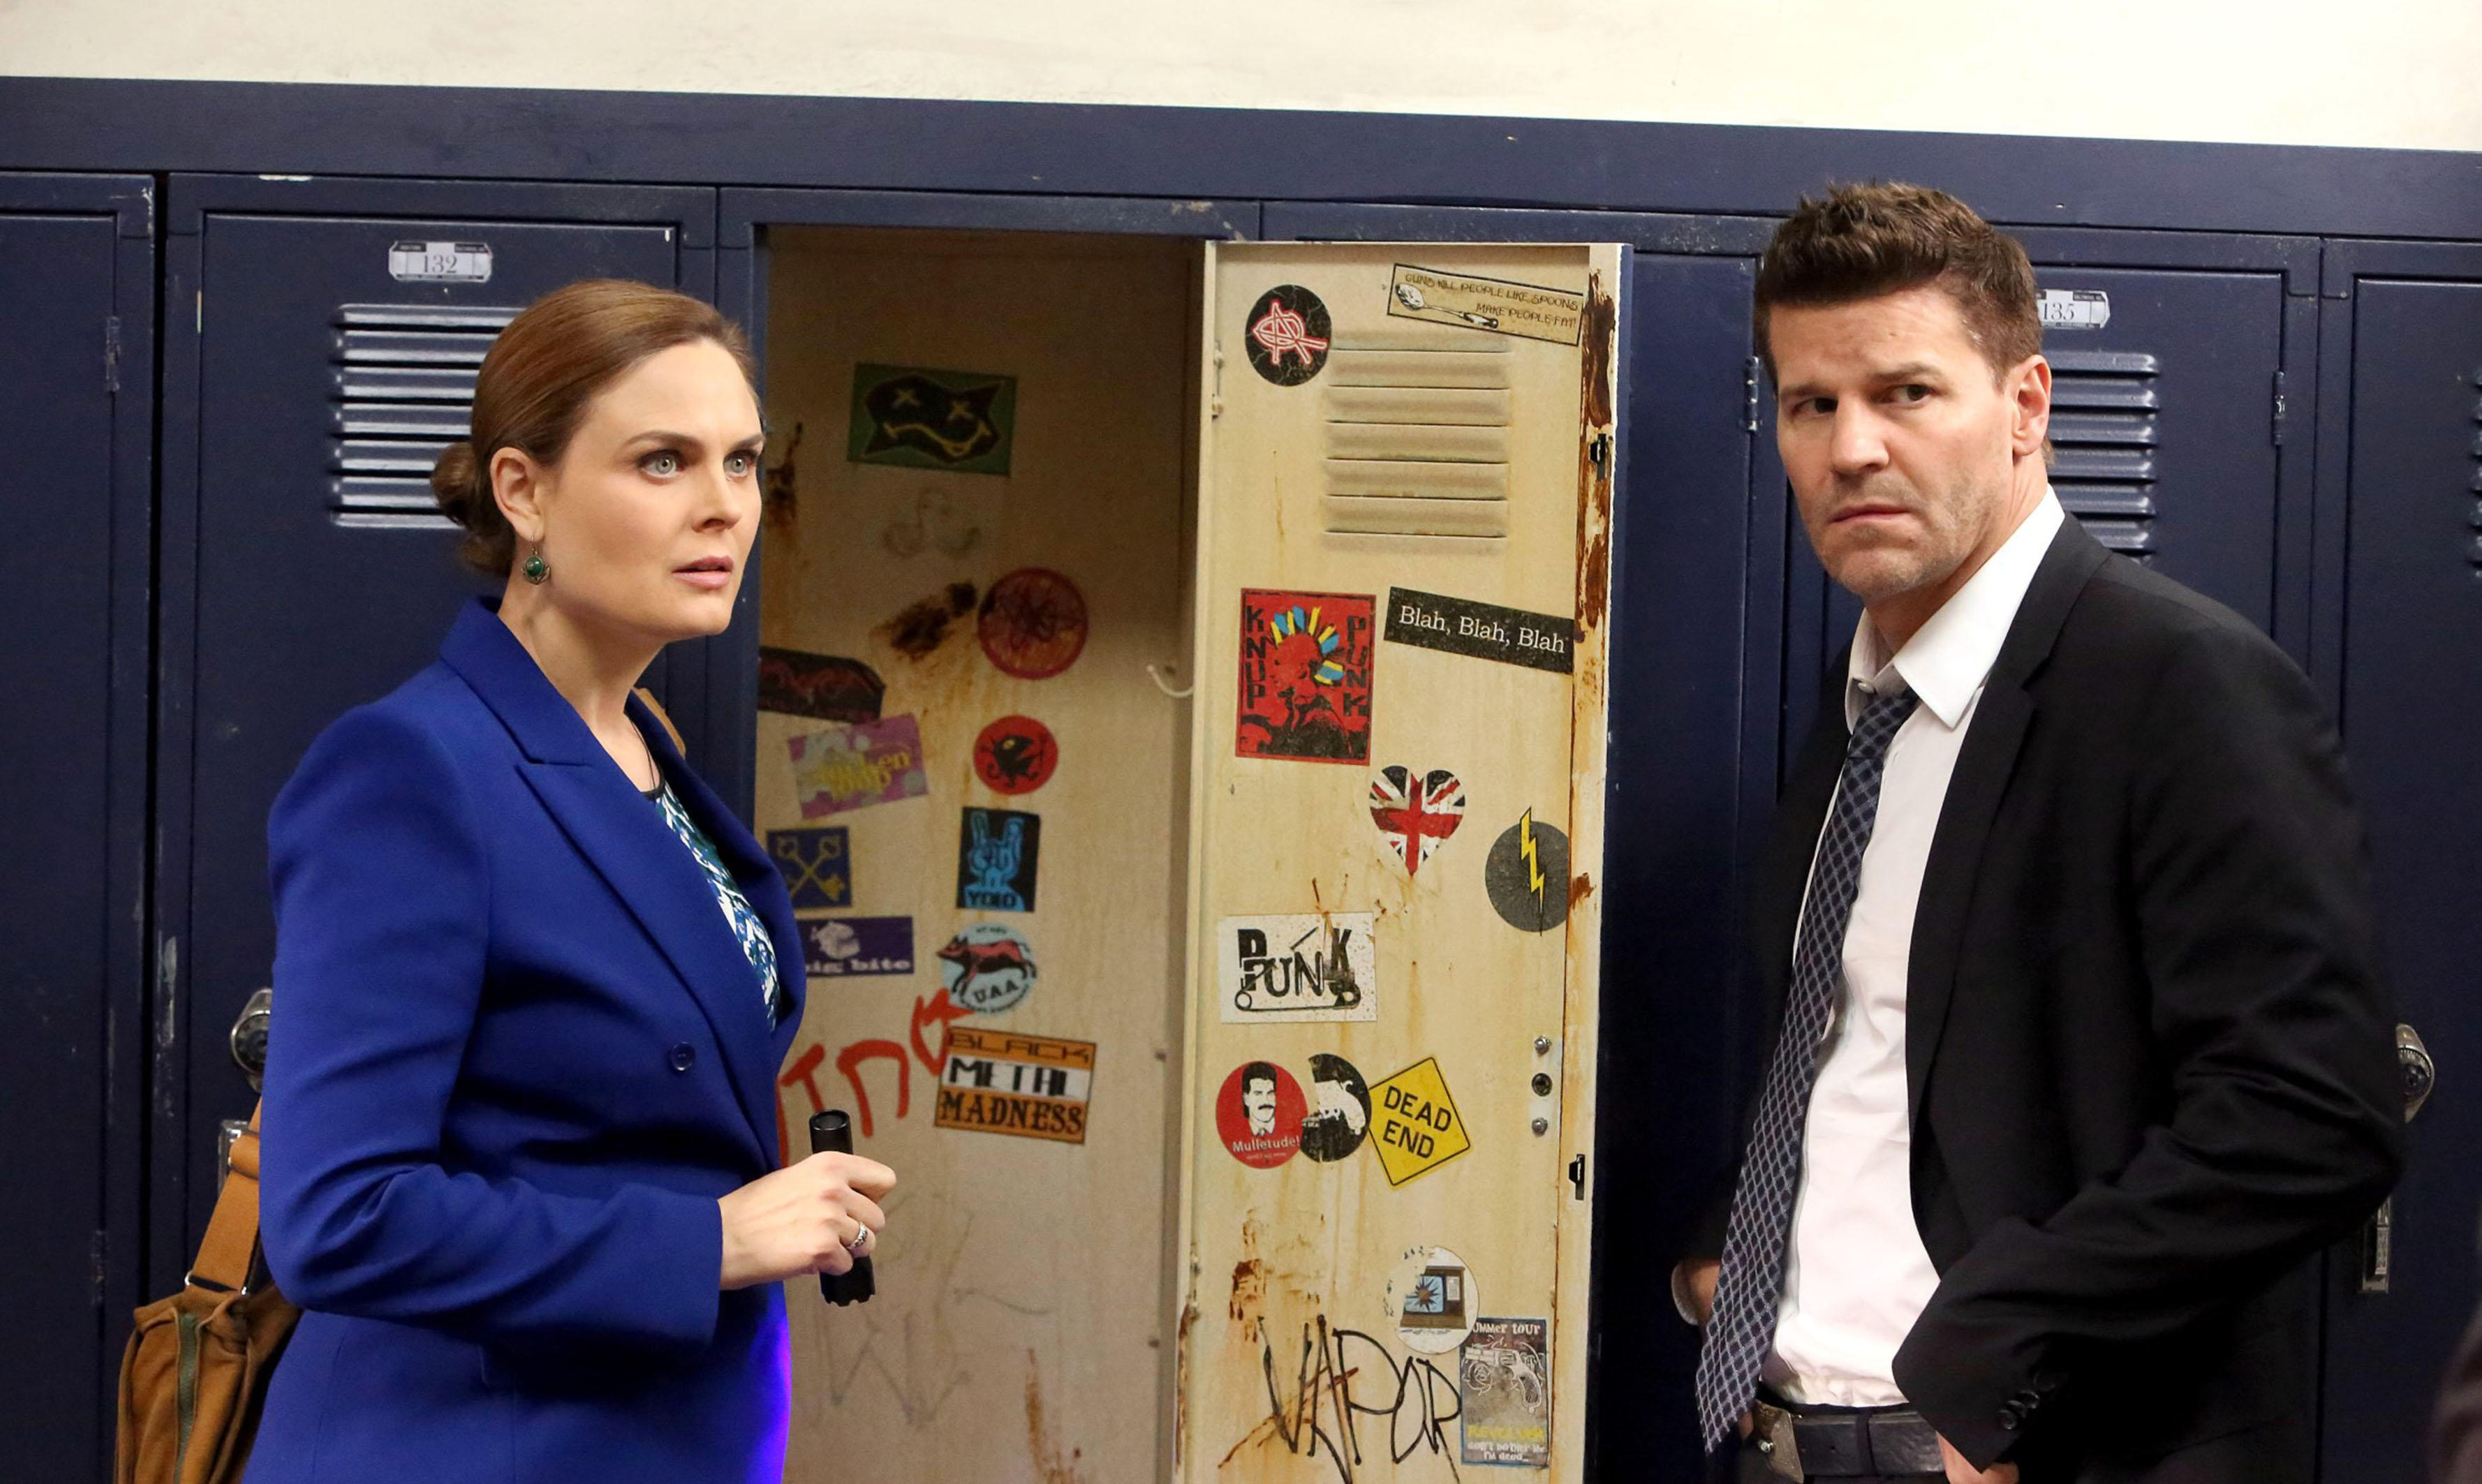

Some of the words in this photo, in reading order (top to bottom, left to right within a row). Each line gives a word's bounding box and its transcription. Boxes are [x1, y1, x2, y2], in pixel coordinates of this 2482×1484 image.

[423, 254, 457, 274] 132
[1405, 274, 1435, 288] GUNS
[1461, 283, 1503, 297] PEOPLE
[1506, 290, 1528, 302] LIKE
[1530, 295, 1578, 311] SPOONS
[1475, 303, 1505, 316] MAKE
[1508, 308, 1551, 323] PEOPLE
[2043, 302, 2074, 320] 135
[1398, 605, 1451, 635] Blah,
[1458, 616, 1510, 646] Blah,
[1517, 628, 1565, 653] Blah
[805, 960, 843, 974] ig
[940, 1090, 1083, 1134] MADNESS
[1384, 1085, 1451, 1132] DEAD
[1232, 1135, 1301, 1152] Mulletude!
[1383, 1119, 1435, 1159] END
